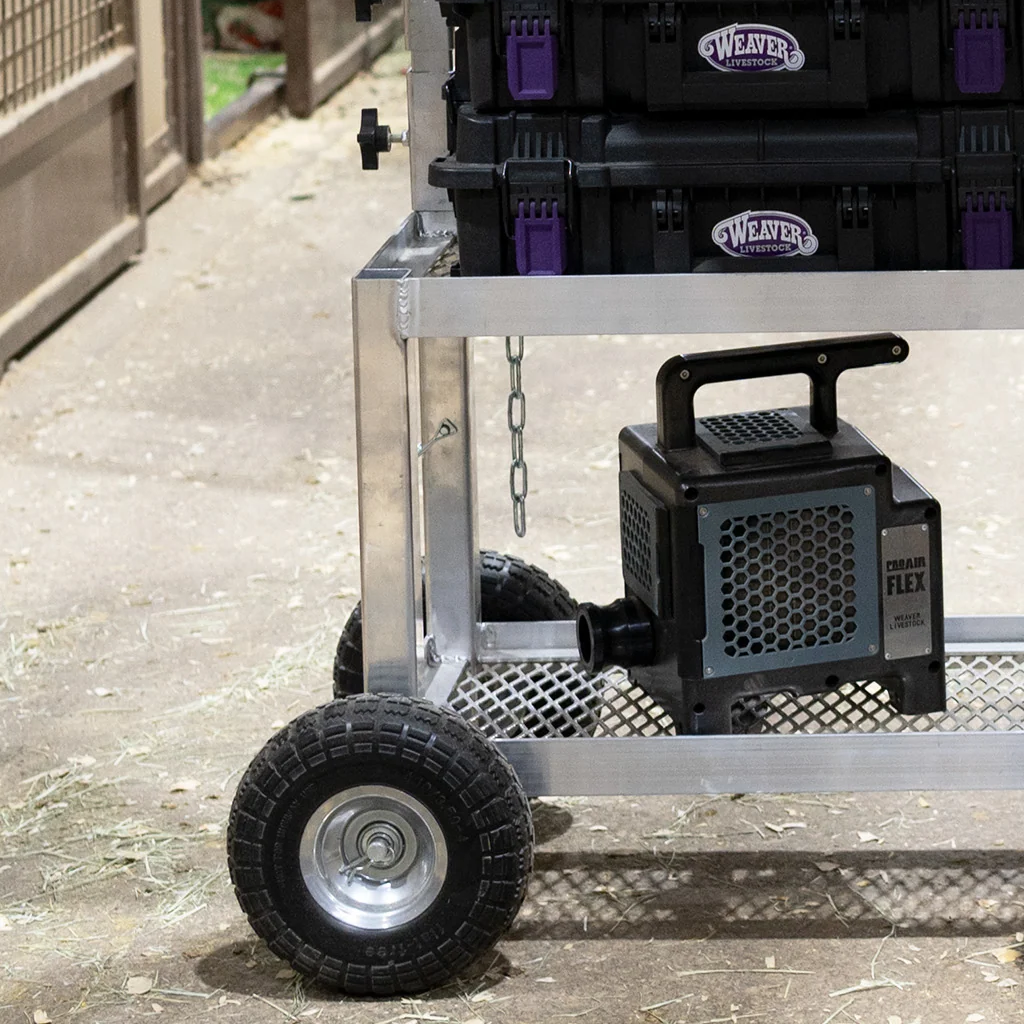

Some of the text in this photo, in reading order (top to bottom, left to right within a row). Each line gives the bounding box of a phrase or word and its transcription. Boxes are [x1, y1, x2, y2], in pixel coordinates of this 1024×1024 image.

[700, 26, 804, 70] WEAVER
[726, 58, 778, 67] LIVESTOCK
[714, 214, 818, 255] WEAVER
[740, 243, 791, 253] LIVESTOCK
[886, 556, 926, 572] PROAIR
[887, 572, 926, 596] FLEX
[894, 613, 921, 622] WEAVER
[890, 620, 925, 630] LIVESTOCK
